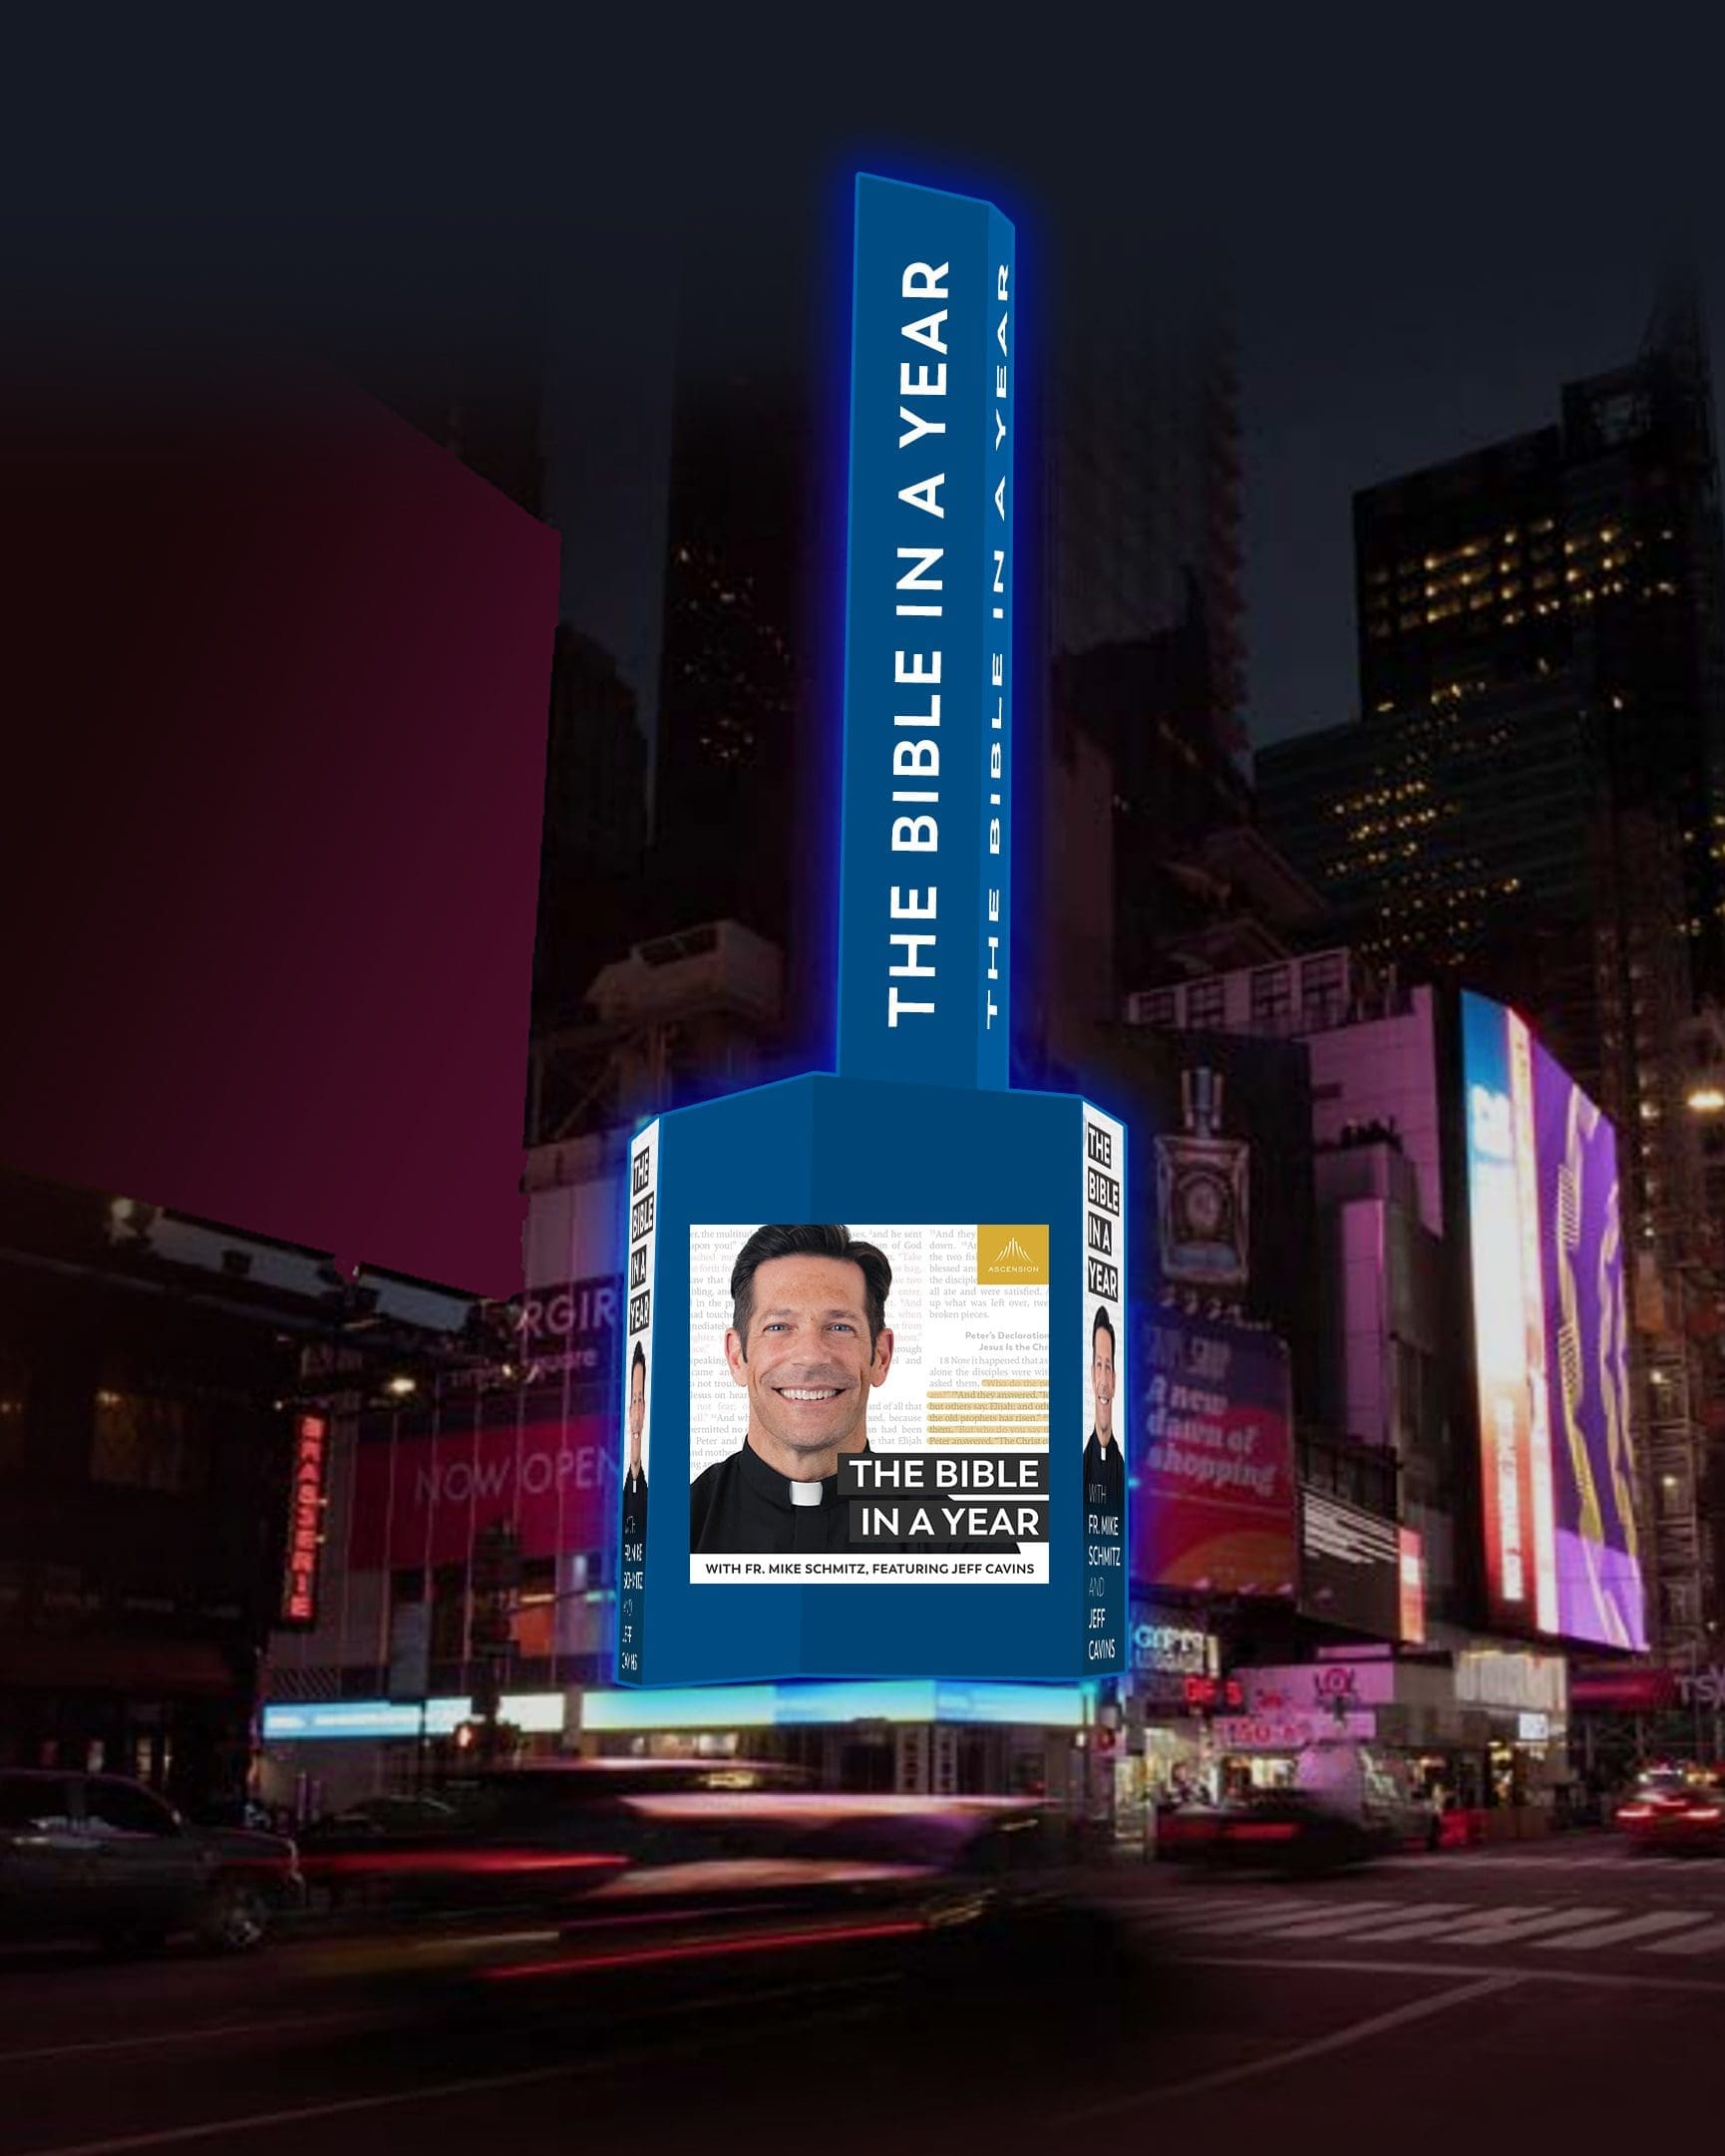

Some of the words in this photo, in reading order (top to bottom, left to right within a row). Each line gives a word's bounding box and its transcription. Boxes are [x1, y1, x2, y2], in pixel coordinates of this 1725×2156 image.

[899, 261, 949, 449] YEAR
[996, 263, 1010, 452] YEAR
[898, 473, 945, 520] A
[994, 476, 1006, 522] A
[895, 547, 945, 617] IN
[993, 549, 1005, 619] IN
[891, 650, 941, 853] BIBLE
[989, 652, 1003, 856] BIBLE
[888, 886, 937, 1028] THE
[986, 889, 999, 1030] THE
[1089, 1128, 1111, 1167] THE
[633, 1154, 649, 1192] THE
[1089, 1170, 1120, 1213] BIBLE
[632, 1196, 654, 1241] BIBLE
[1089, 1216, 1101, 1248] IN
[1103, 1221, 1111, 1253] A
[903, 1241, 922, 1250] God
[929, 1263, 960, 1273] blessed
[1089, 1259, 1118, 1298] YEAR
[959, 1286, 976, 1295] and
[629, 1294, 650, 1332] YEAR
[929, 1310, 959, 1319] broken
[979, 1342, 1004, 1351] Jesus
[849, 1459, 924, 1488] THE
[936, 1459, 1039, 1488] BIBLE
[862, 1507, 899, 1536] IN
[907, 1507, 935, 1536] A
[941, 1507, 1040, 1536] YEAR
[1101, 1516, 1119, 1536] MIKE
[706, 1564, 741, 1575] WITH
[745, 1564, 766, 1575] FR.
[769, 1564, 802, 1575] MIKE
[805, 1564, 868, 1576] SCHMITZ,
[872, 1564, 948, 1575] FEATURING
[951, 1564, 982, 1575] JEFF
[985, 1564, 1035, 1575] CAVINS
[1088, 1546, 1121, 1567] SCHMITZ
[1089, 1608, 1106, 1628] JEFF
[1089, 1638, 1116, 1660] CAVINS
